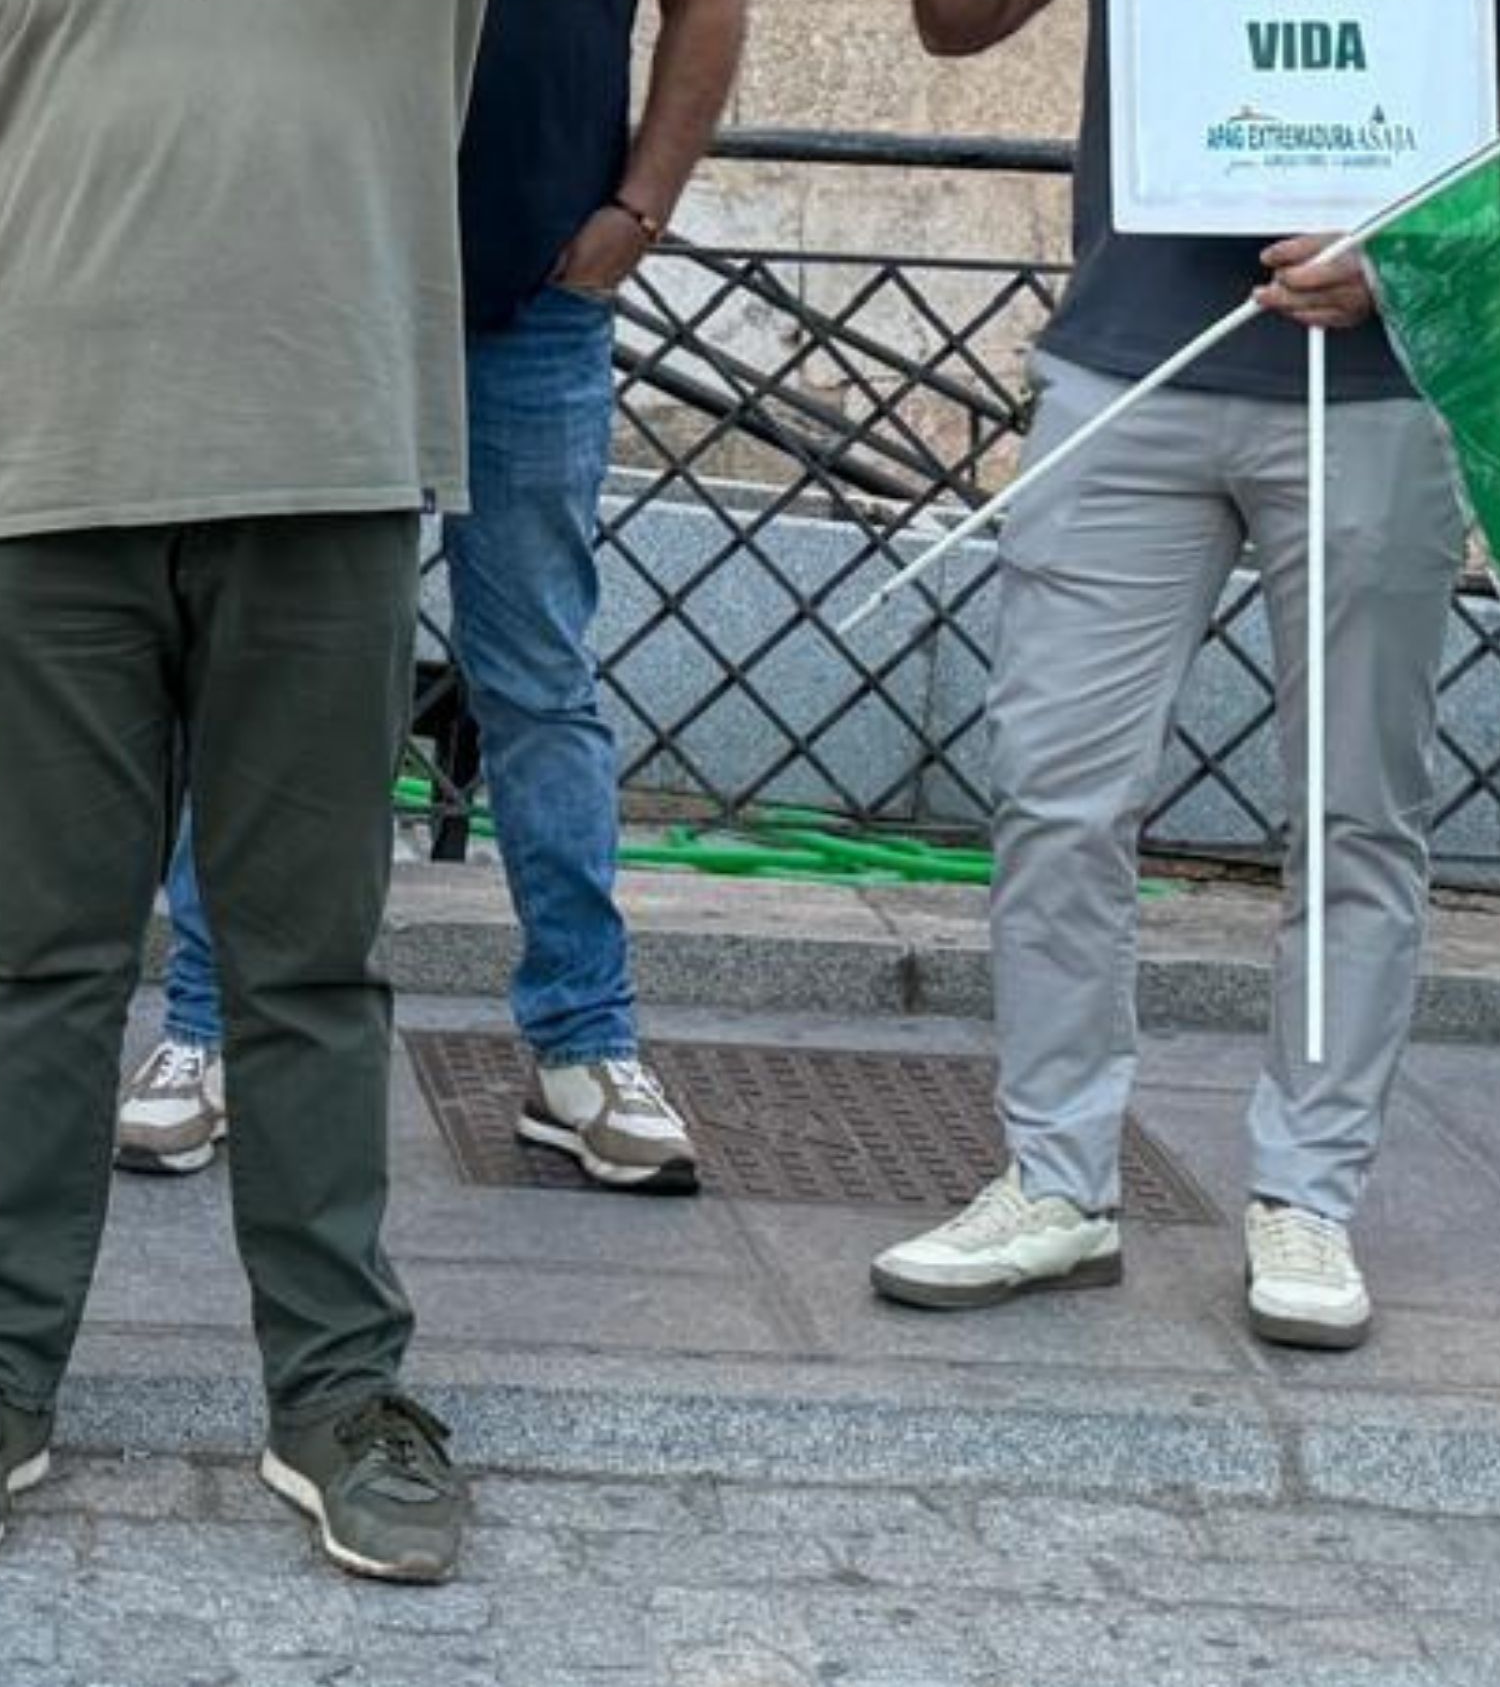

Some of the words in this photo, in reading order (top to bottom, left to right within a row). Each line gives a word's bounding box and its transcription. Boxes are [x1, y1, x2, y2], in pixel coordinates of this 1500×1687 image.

[1247, 21, 1367, 71] VIDA
[1206, 123, 1245, 150] APAG
[1249, 123, 1355, 151] EXTREMADURA
[1357, 123, 1416, 155] ASAJA
